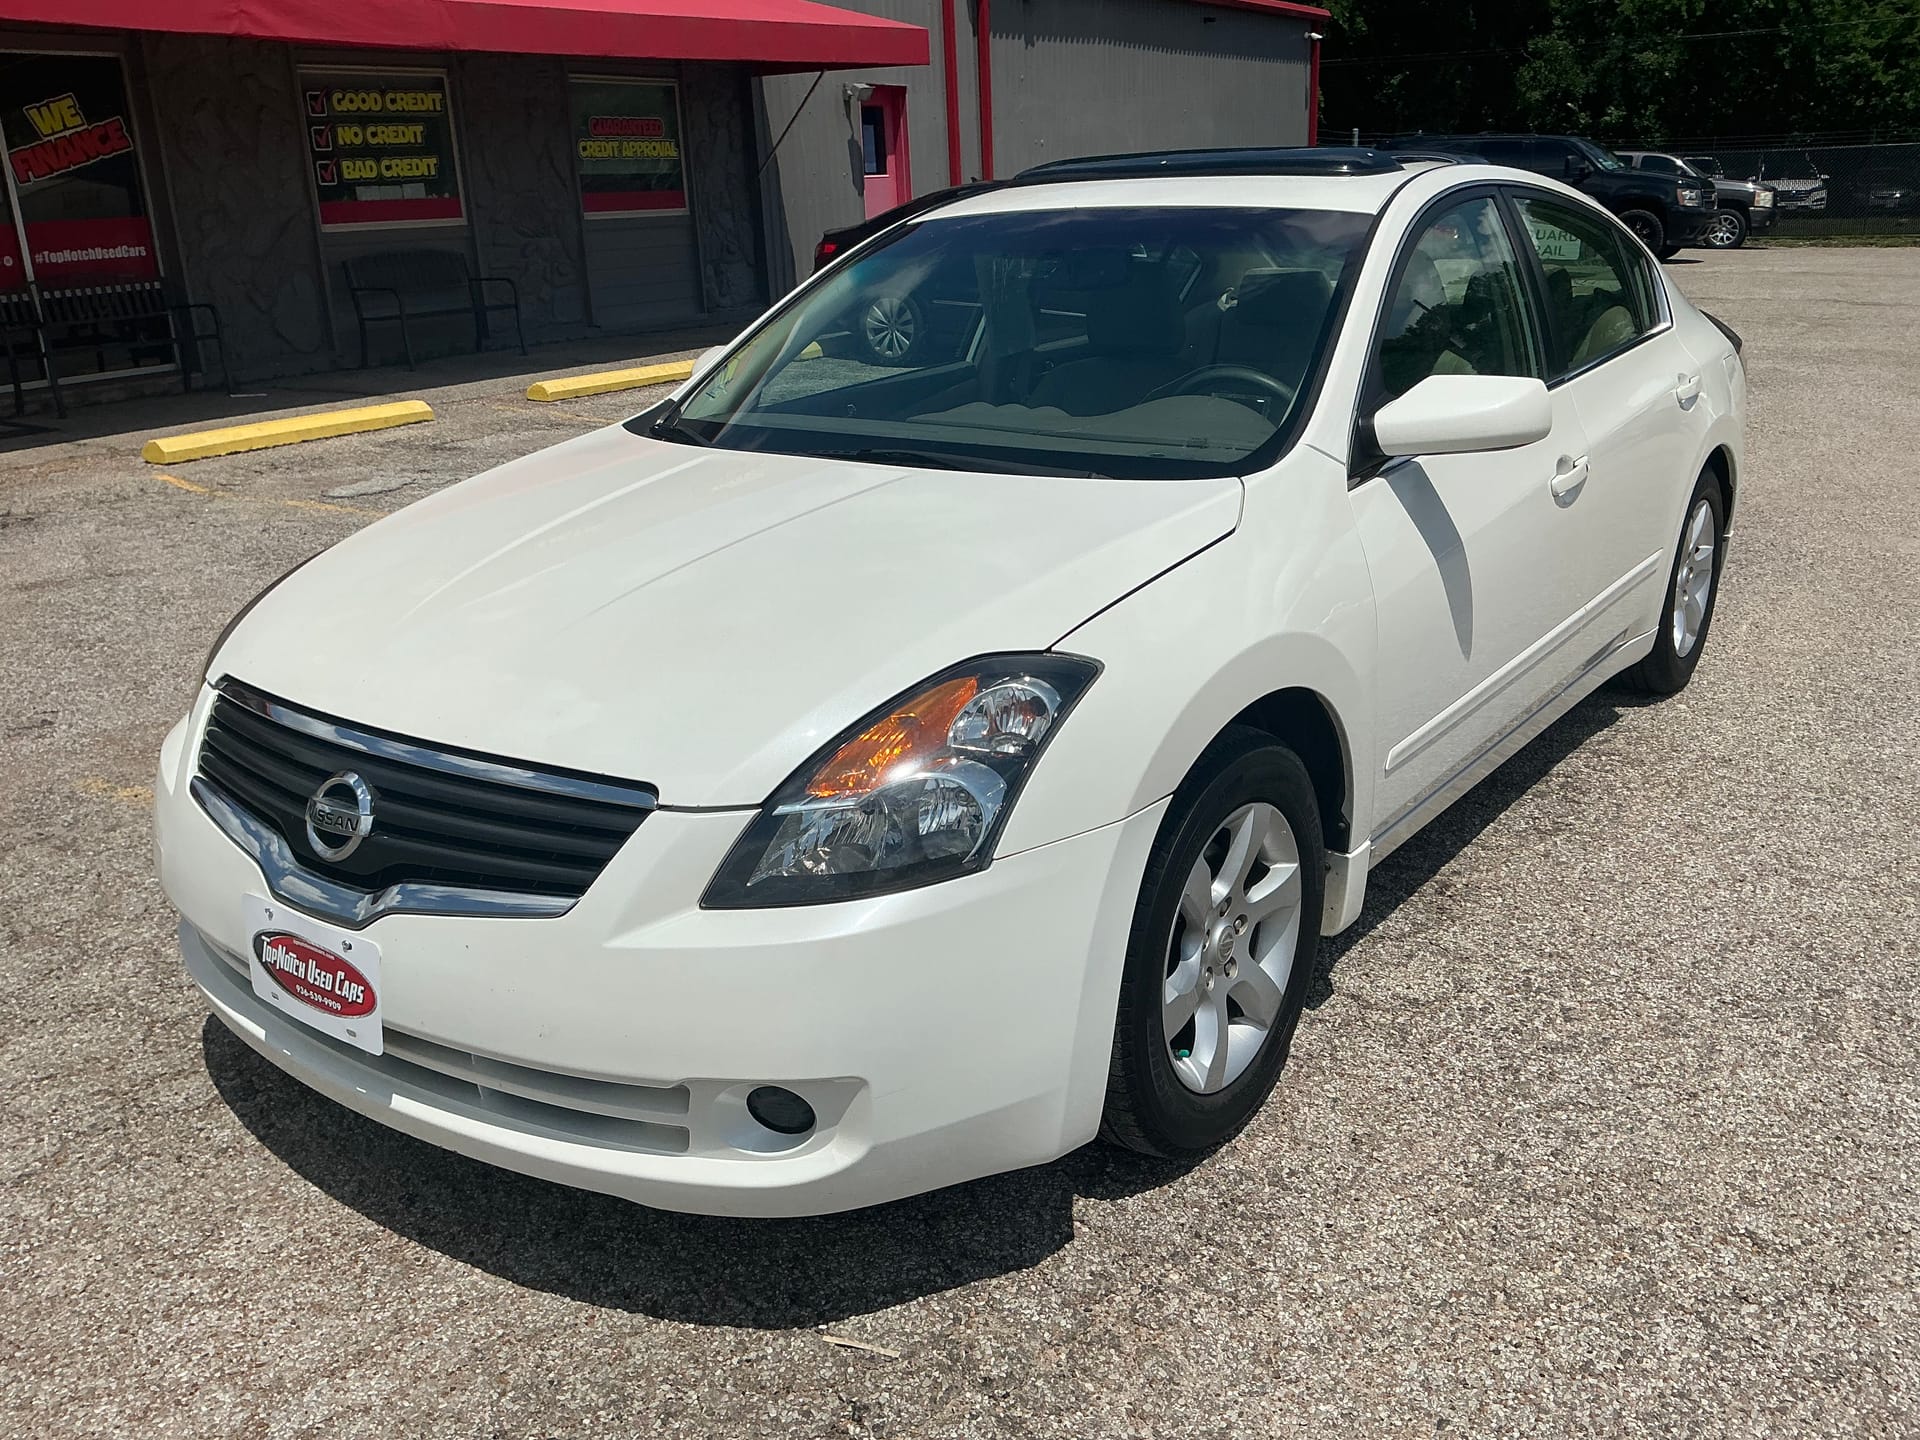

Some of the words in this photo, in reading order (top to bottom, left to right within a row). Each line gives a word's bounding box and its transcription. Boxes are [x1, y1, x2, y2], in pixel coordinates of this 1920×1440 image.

[332, 91, 383, 112] GOOD
[385, 91, 443, 112] CREDIT
[26, 95, 85, 135] WE
[336, 126, 363, 146] NO
[366, 125, 425, 145] CREDIT
[590, 117, 663, 137] GUARANTEED
[9, 117, 132, 184] FINANCE
[579, 139, 620, 157] CREDIT
[622, 140, 679, 157] APPROVAL
[341, 159, 378, 180] BAD
[380, 157, 437, 178] CREDIT
[1533, 229, 1578, 242] UARD
[34, 245, 147, 264] #TopNotchUsedCars
[310, 804, 359, 831] NISSAN
